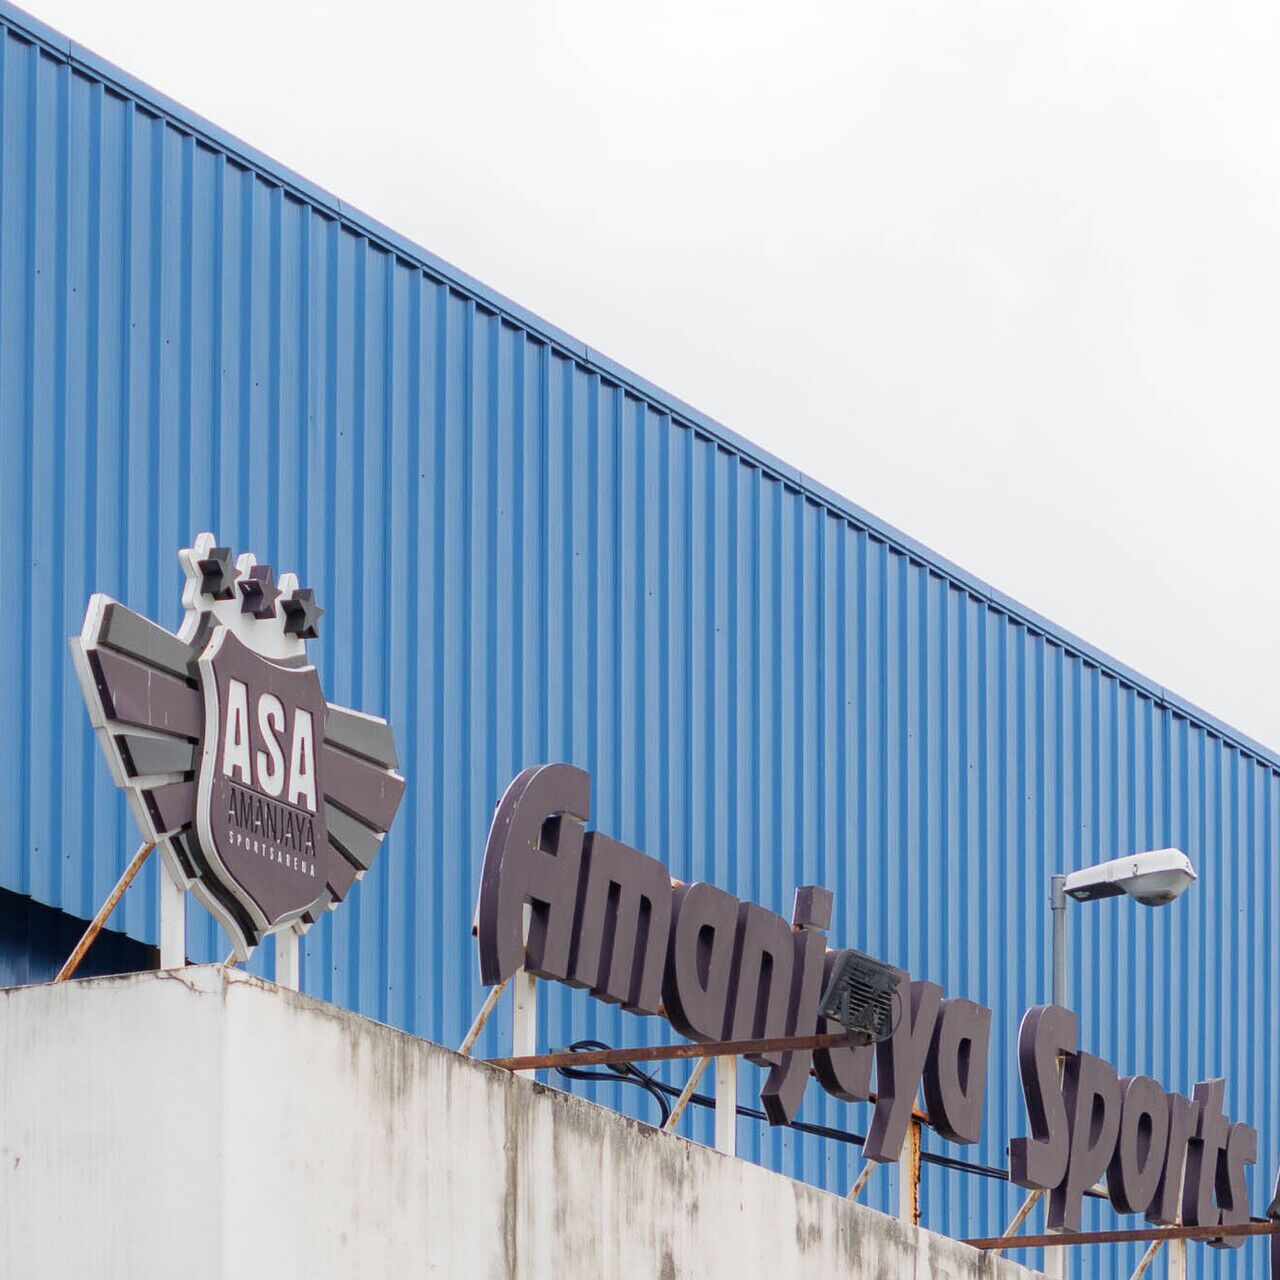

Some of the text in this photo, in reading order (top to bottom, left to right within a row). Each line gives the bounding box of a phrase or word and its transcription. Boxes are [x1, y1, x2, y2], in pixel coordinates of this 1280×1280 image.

[222, 678, 318, 812] ASA
[227, 786, 316, 858] AMANJAYA
[1009, 1004, 1258, 1249] Sports
